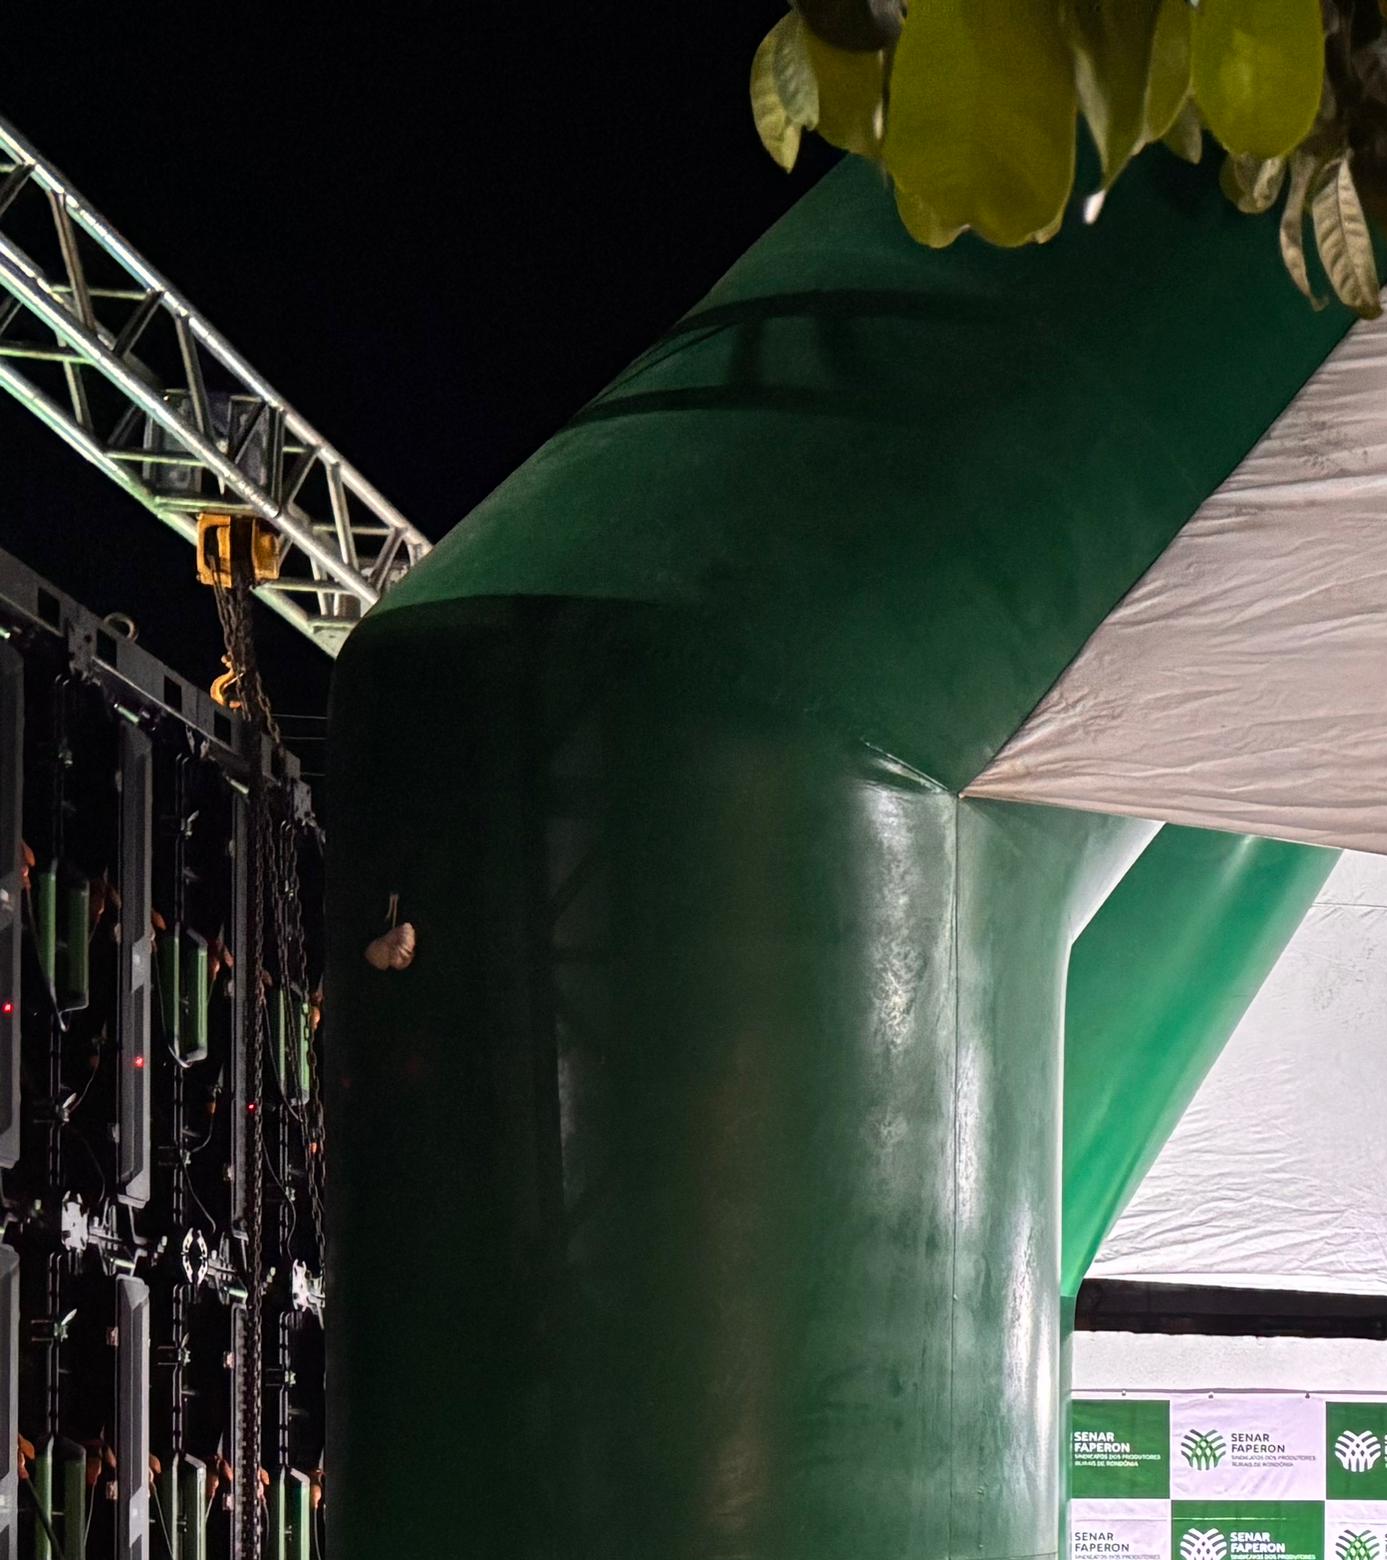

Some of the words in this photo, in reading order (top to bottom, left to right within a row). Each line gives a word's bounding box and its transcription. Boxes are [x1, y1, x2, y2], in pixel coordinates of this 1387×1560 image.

[1074, 1431, 1115, 1442] SENAR
[1231, 1433, 1270, 1442] SENAR
[1074, 1442, 1130, 1453] FAPERON
[1231, 1444, 1285, 1453] FAPERON
[1074, 1532, 1114, 1541] SENAR
[1230, 1532, 1270, 1542] SENAR
[1075, 1543, 1130, 1552] FAPERON
[1230, 1543, 1285, 1553] FAPERON
